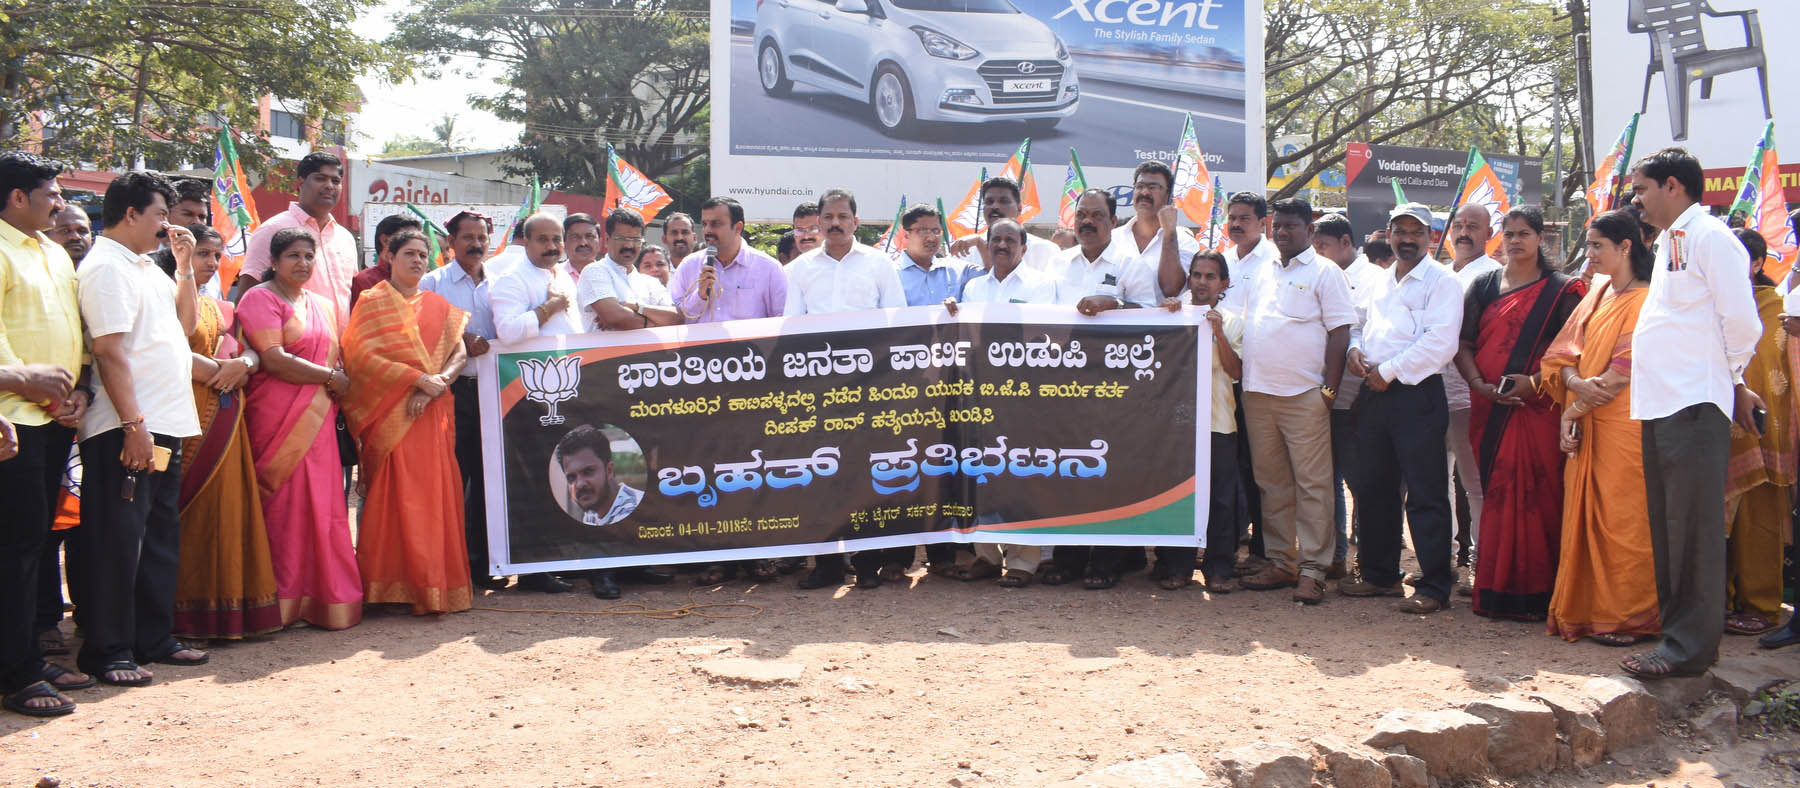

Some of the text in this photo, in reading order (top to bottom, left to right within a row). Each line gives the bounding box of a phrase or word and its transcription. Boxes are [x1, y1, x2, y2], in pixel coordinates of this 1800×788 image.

[1094, 28, 1216, 45] The Stylish Family Sedan
[1134, 149, 1157, 160] Test
[1378, 159, 1421, 172] Vodafone
[1408, 176, 1421, 186] Calls
[1423, 178, 1434, 186] and
[1435, 178, 1449, 187] Data
[728, 186, 814, 196] www.hyundai.co.in
[617, 346, 768, 394] ಭಾರತೀಯ
[782, 341, 874, 378] ಜನತಾ
[889, 341, 972, 372] ಪಾರ್ಟಿ
[987, 333, 1088, 369] ಉಡುಪಿ
[629, 395, 721, 418] ಮಂಗಳೂರಿನ
[822, 385, 862, 407] ನಡೆದ
[868, 382, 919, 402] ಹಿಂದೂ
[924, 378, 974, 399] ಯುವಕ
[979, 378, 1031, 398] ಬಿ.ಜೆ.ಪಿ
[764, 415, 817, 436] ದೀಪಕ್
[823, 411, 865, 432] ರಾವ್
[949, 405, 995, 424] ಖಂಡಿಸಿ
[656, 435, 1110, 509] ಬೃಹತ್ ಪ್ರತಿಭಟನೆ
[906, 502, 938, 518] ಸರ್ಕಲ್
[757, 514, 800, 531] ಗುರುವಾರ
